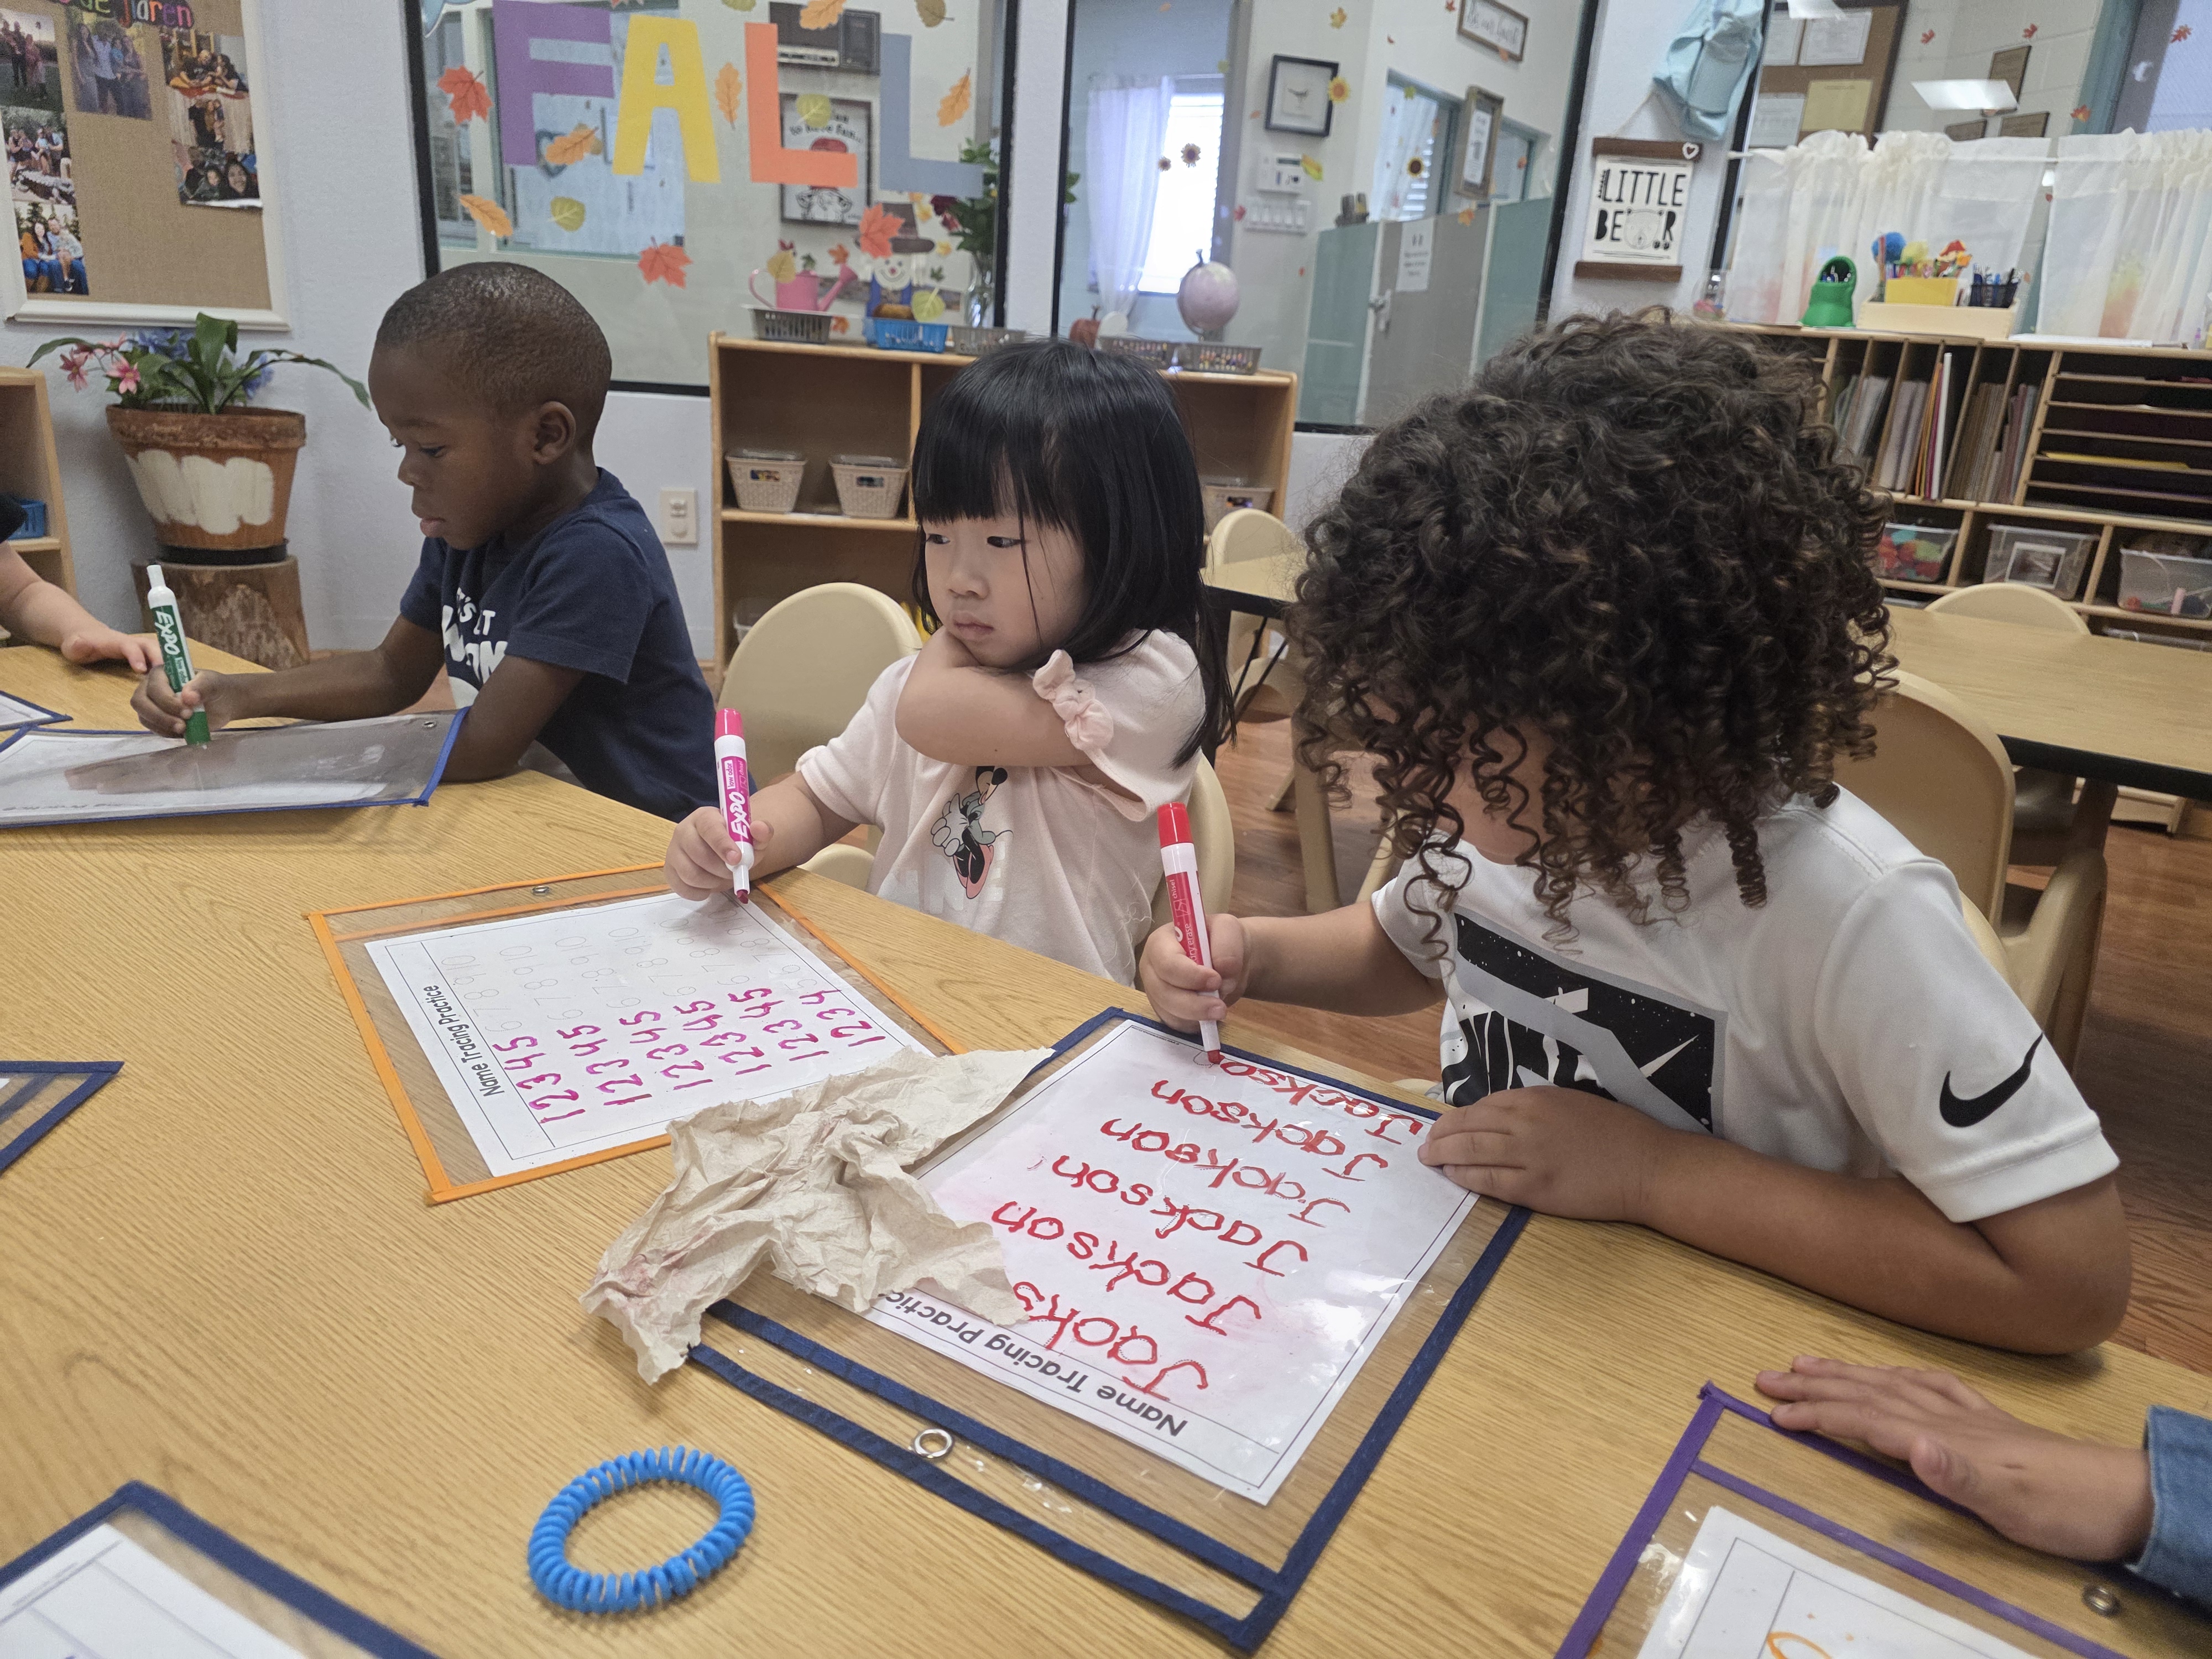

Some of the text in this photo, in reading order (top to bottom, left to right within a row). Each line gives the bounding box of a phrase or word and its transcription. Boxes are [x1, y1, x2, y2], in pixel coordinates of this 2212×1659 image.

[492, 0, 985, 198] FALL
[1600, 169, 1686, 206] LITTLE
[154, 611, 181, 655] EXPO
[728, 791, 750, 839] EXPO
[1170, 879, 1178, 899] chisel
[1185, 923, 1194, 945] erase
[423, 985, 505, 1097] Name Tracing Practice
[1100, 1118, 1351, 1228] Jackson
[1151, 1079, 1389, 1181] Jackson
[992, 1201, 1262, 1336] Jackson
[1052, 1155, 1308, 1276] Jackson
[878, 1289, 1188, 1437] Name Tracing Practic
[1013, 1281, 1208, 1401] Jacks
